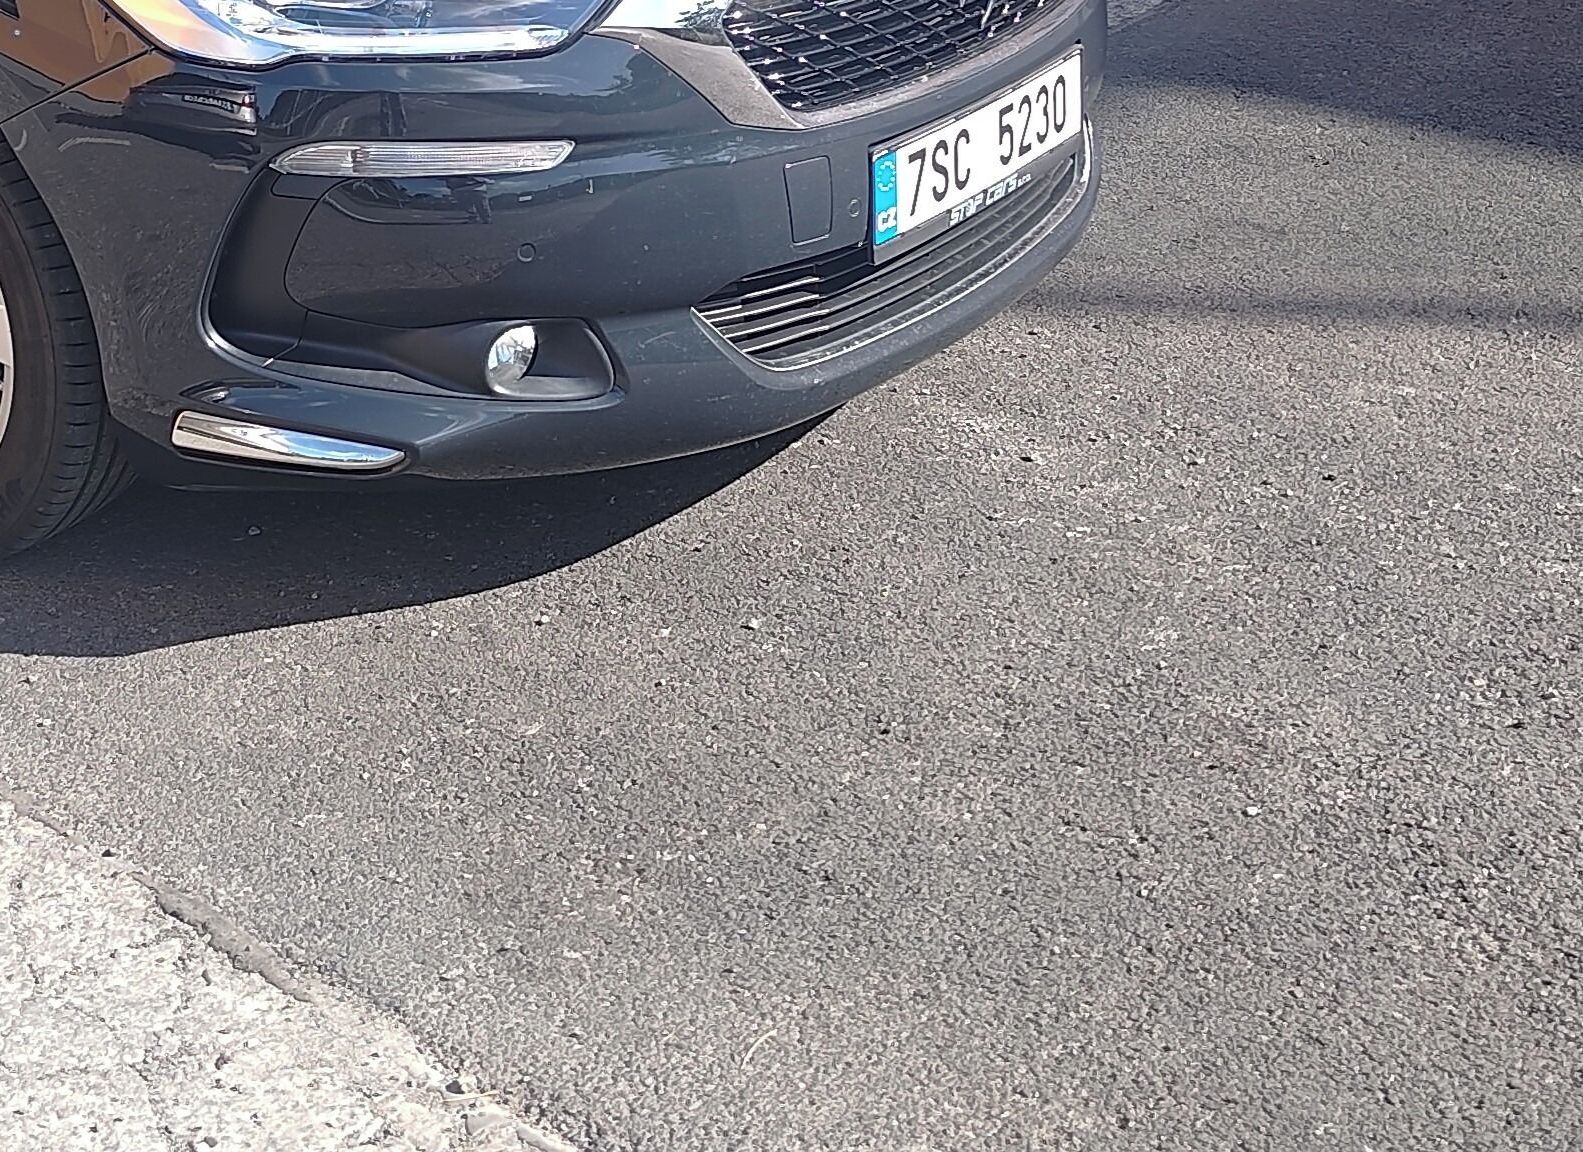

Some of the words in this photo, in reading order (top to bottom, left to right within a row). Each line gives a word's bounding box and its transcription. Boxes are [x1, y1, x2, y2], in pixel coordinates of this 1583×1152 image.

[908, 128, 971, 217] 7SC
[999, 74, 1066, 166] 5230
[876, 205, 897, 233] CZ
